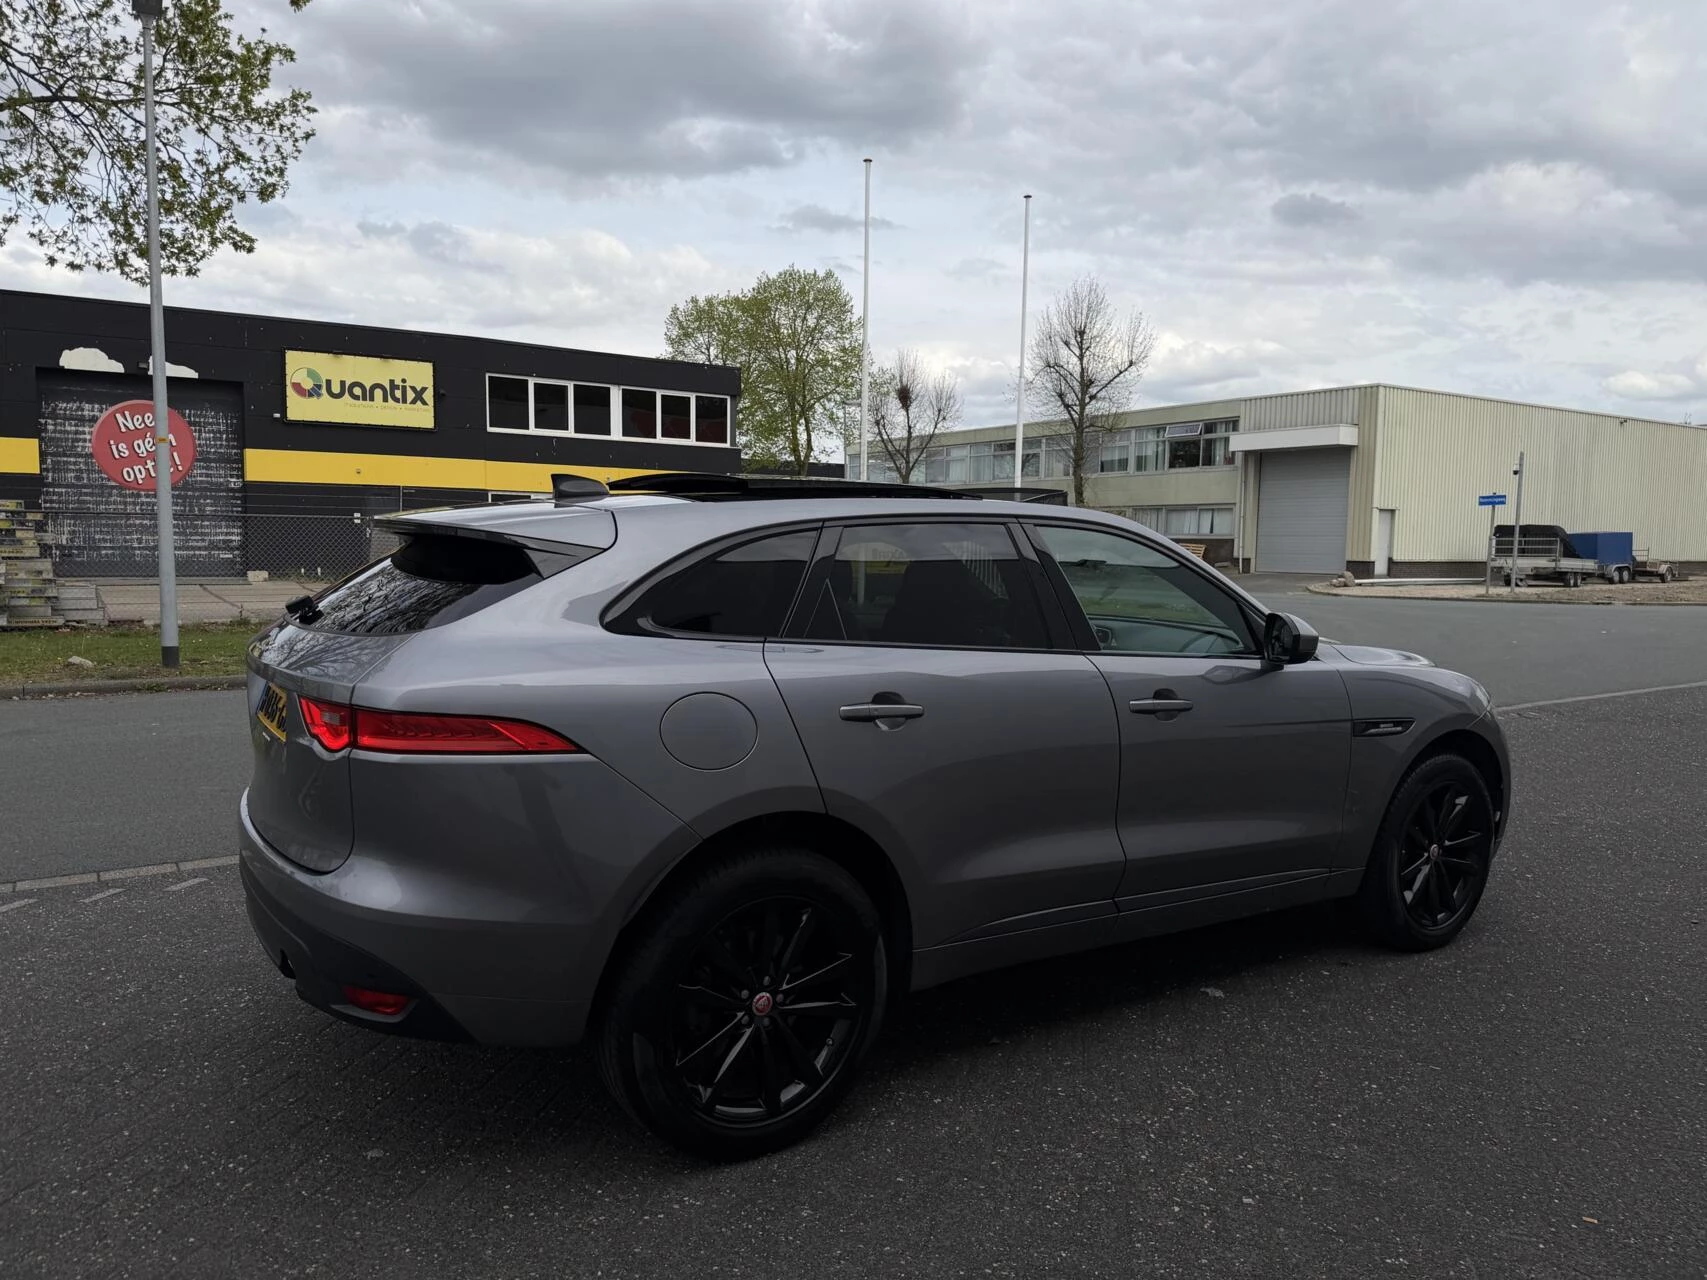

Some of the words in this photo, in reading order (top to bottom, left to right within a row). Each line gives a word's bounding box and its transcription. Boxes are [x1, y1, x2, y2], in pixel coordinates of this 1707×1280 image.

[290, 366, 429, 406] Quantix
[115, 410, 155, 432] Nee
[109, 439, 129, 459] is
[134, 432, 176, 457] gén
